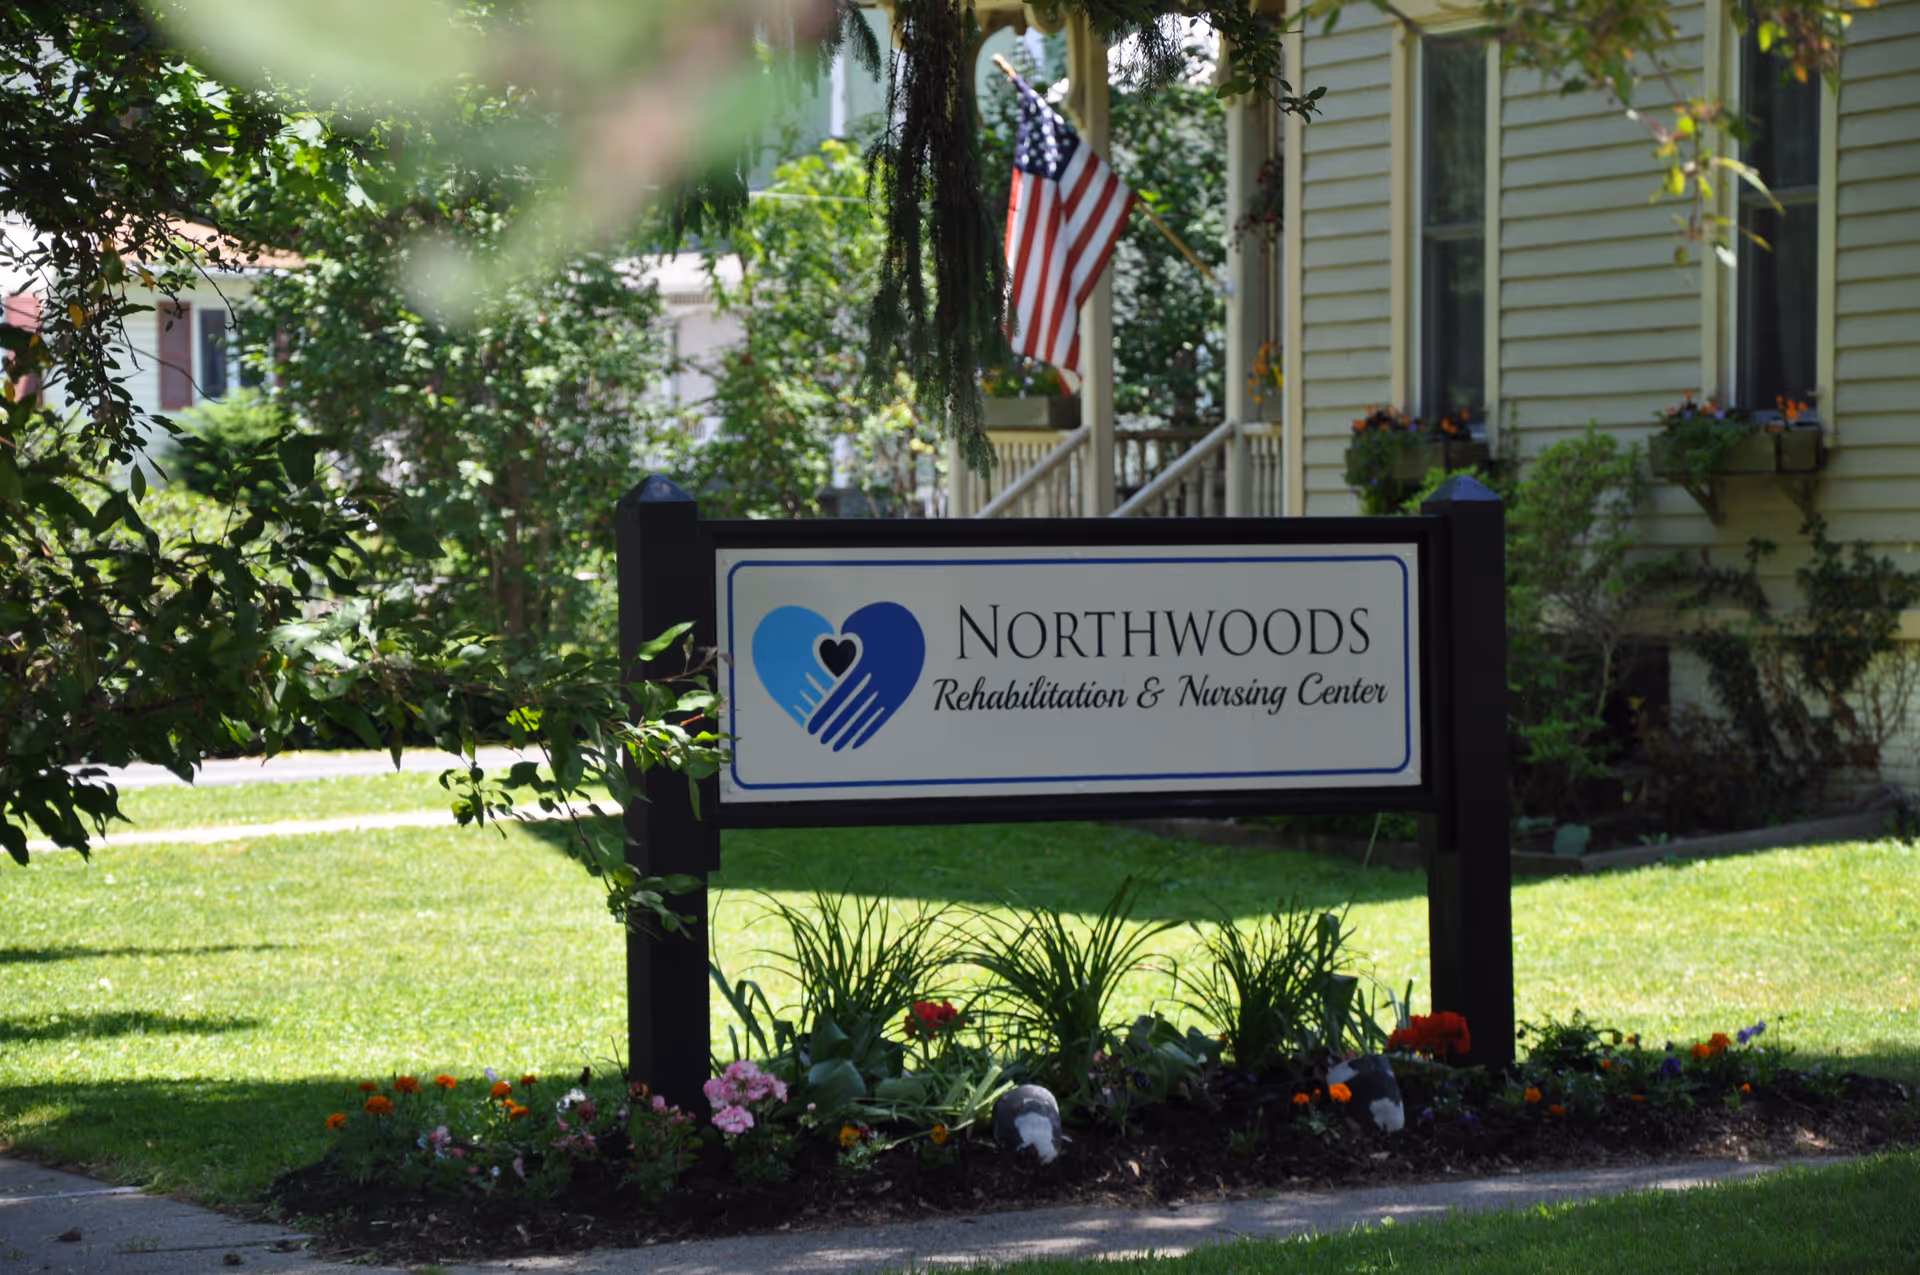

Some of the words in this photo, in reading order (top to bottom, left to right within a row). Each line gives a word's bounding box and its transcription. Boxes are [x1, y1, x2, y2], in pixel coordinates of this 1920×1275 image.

[957, 604, 1370, 659] NORTHWOODS
[933, 676, 1128, 711] Rehabilitation
[1136, 677, 1165, 708] &
[1178, 675, 1287, 715] Nursing
[1297, 672, 1388, 705] Center
